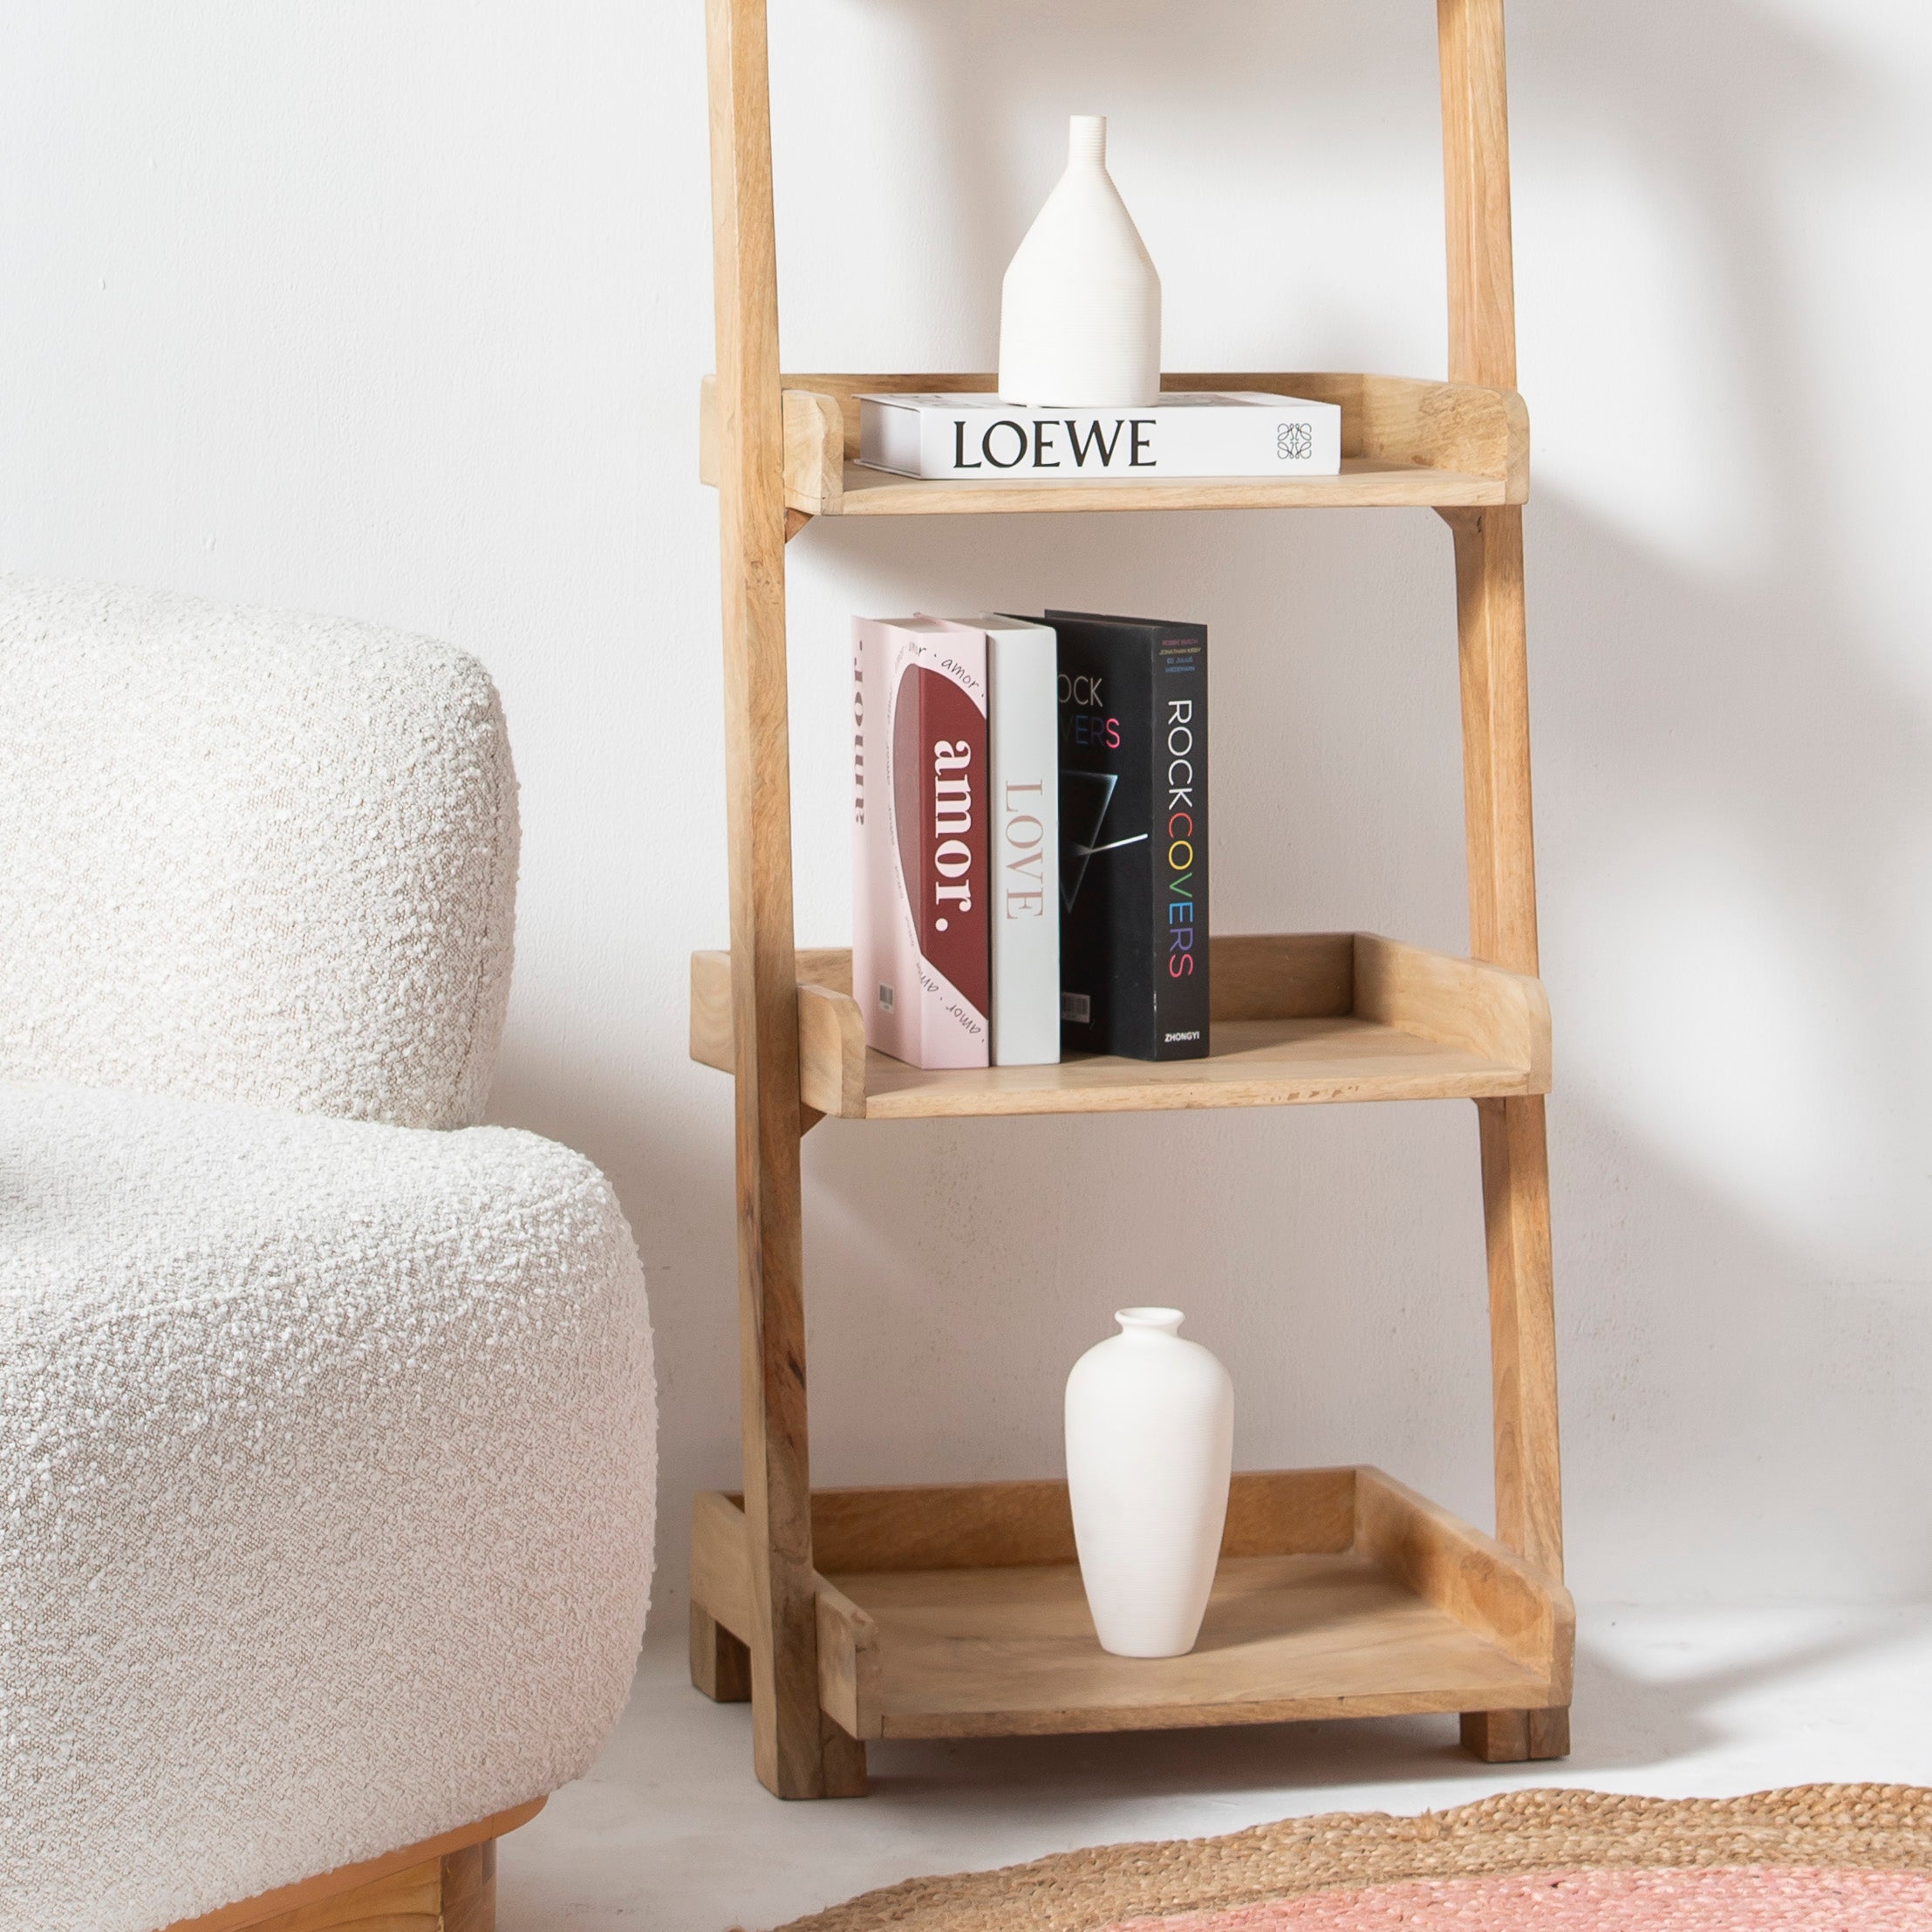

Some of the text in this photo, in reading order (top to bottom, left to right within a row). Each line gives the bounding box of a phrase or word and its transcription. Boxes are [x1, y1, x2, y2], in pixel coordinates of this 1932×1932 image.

[952, 419, 1157, 469] LOEWE
[940, 659, 980, 688] amor
[1058, 673, 1103, 707] OCK
[934, 740, 972, 932] amor.
[1006, 779, 1044, 919] LOVE
[946, 1003, 981, 1034] amor
[1164, 1031, 1200, 1043] ZHONGYI
